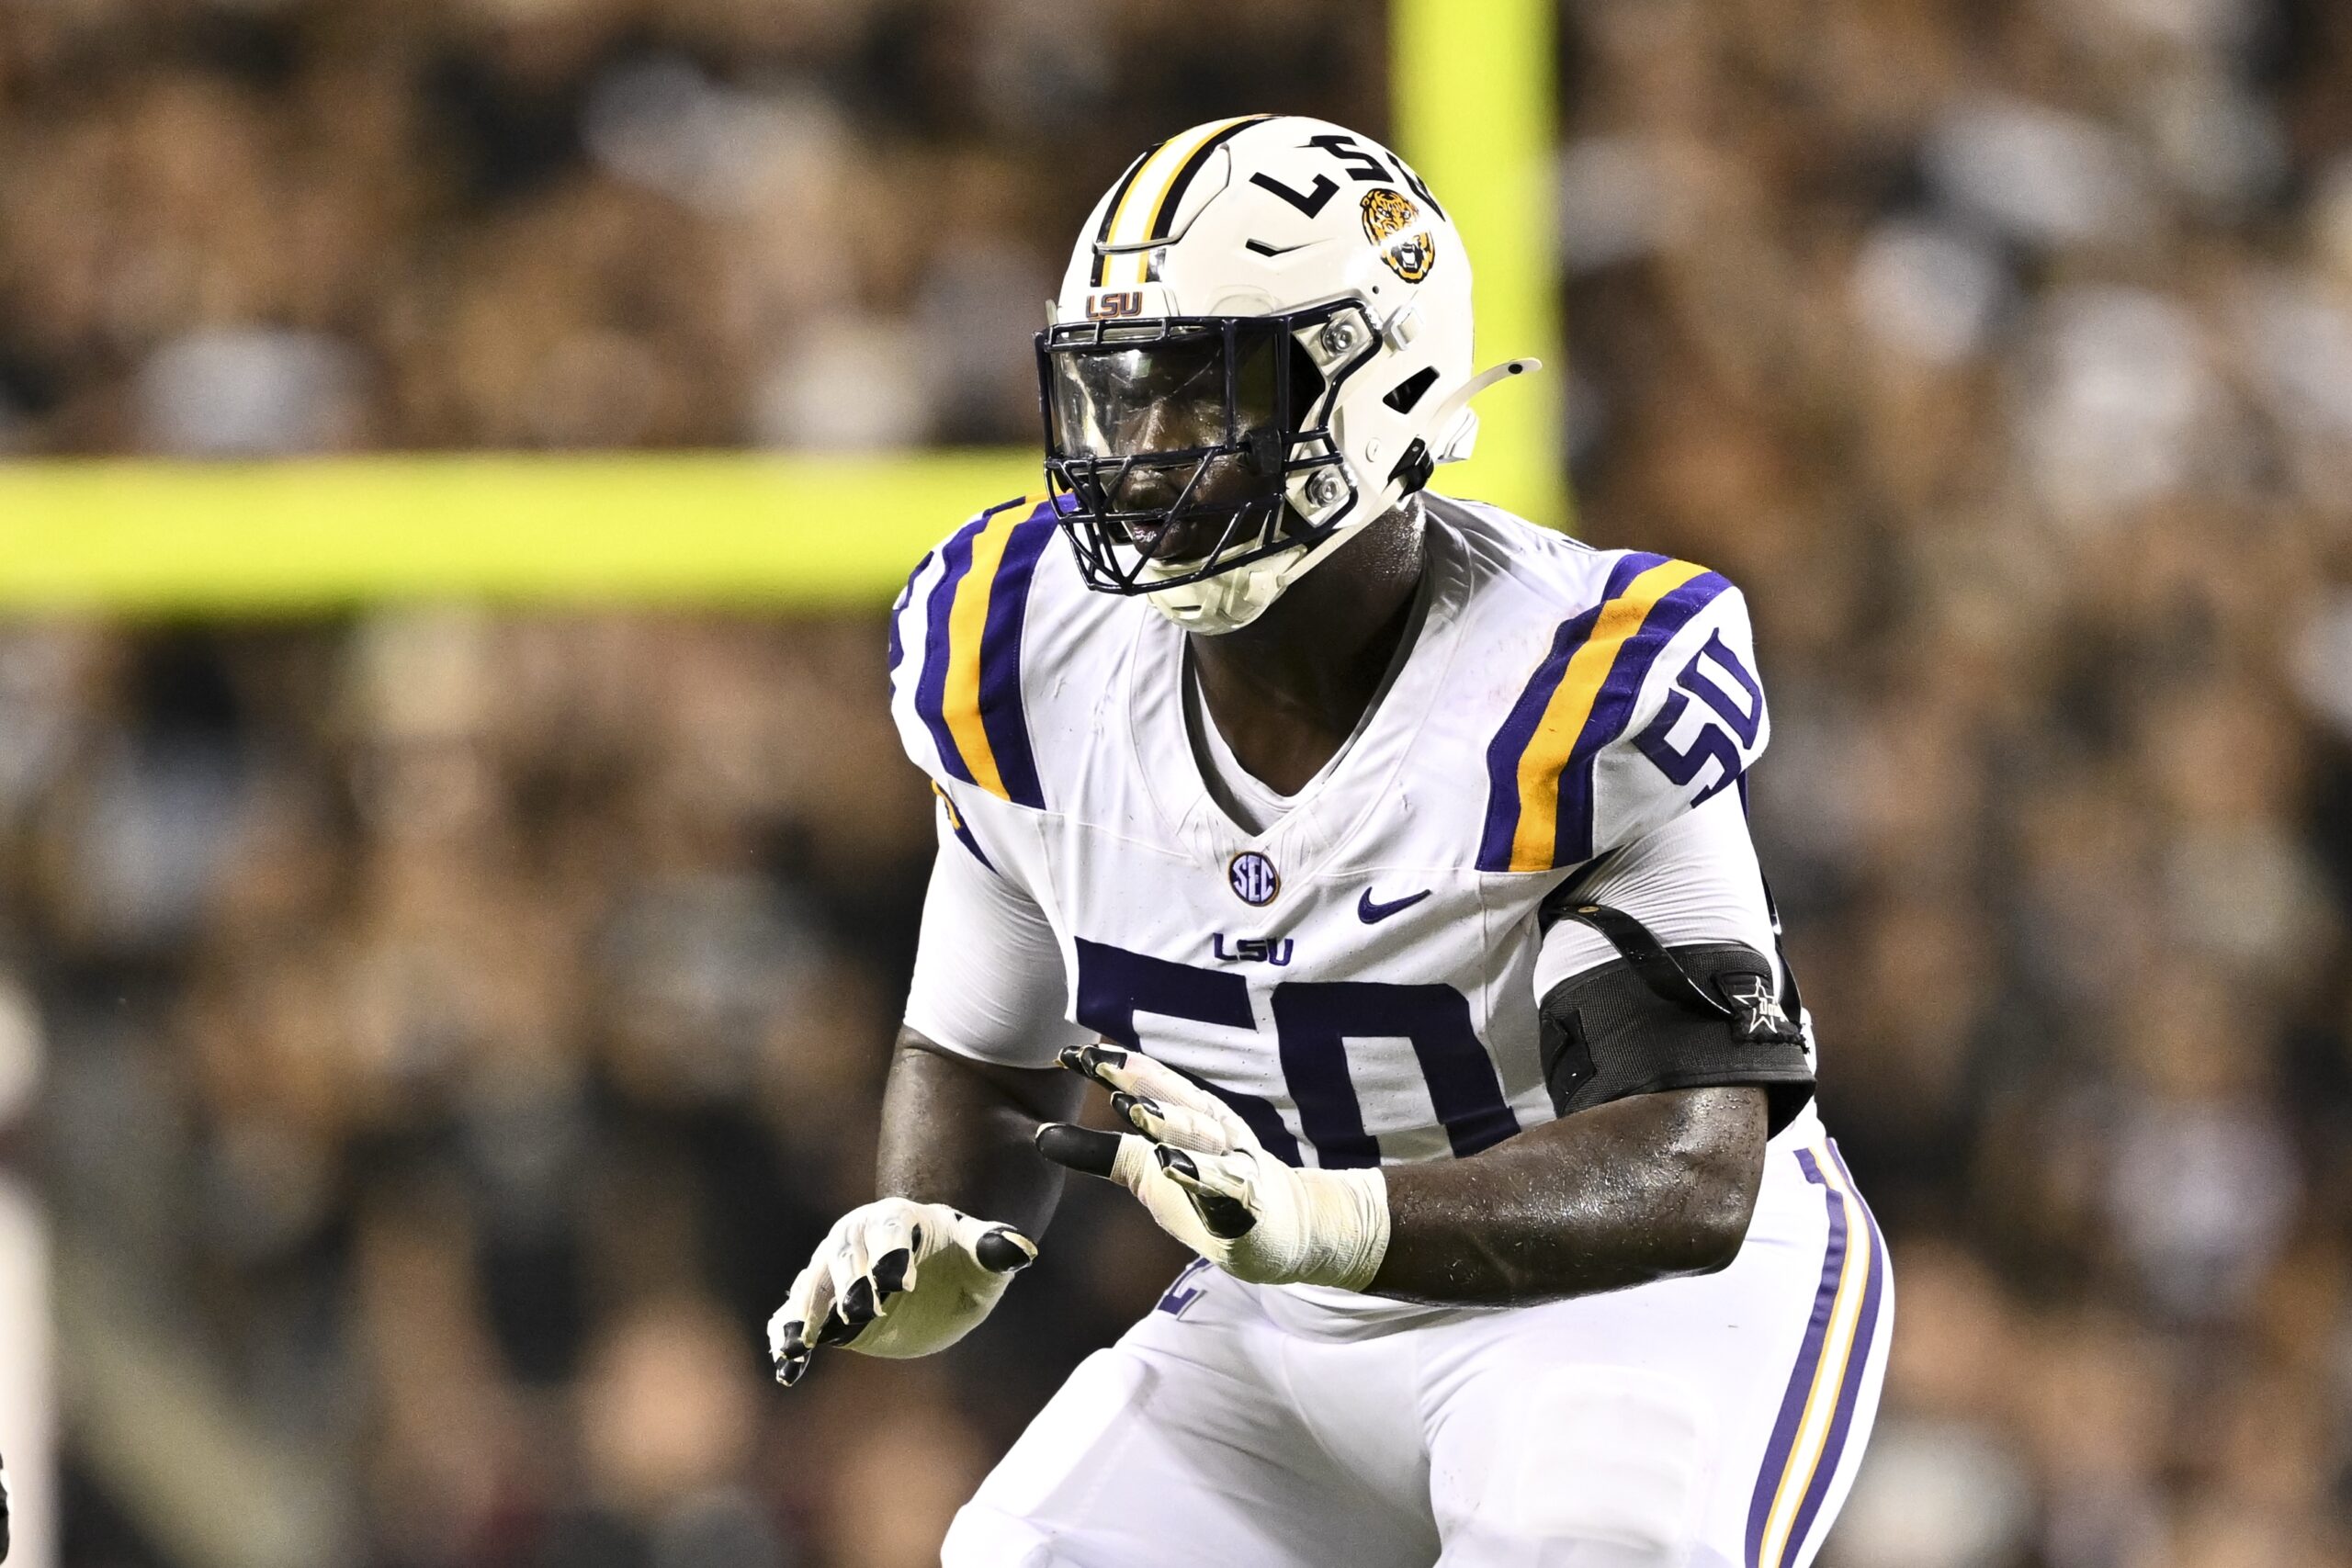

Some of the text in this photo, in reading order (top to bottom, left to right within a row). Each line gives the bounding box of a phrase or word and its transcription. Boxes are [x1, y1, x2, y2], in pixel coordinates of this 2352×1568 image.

[1086, 291, 1143, 321] LSU
[1630, 626, 1763, 809] 50
[1231, 852, 1275, 903] SEC
[1213, 932, 1294, 966] LSU
[1075, 936, 1521, 1168] 50
